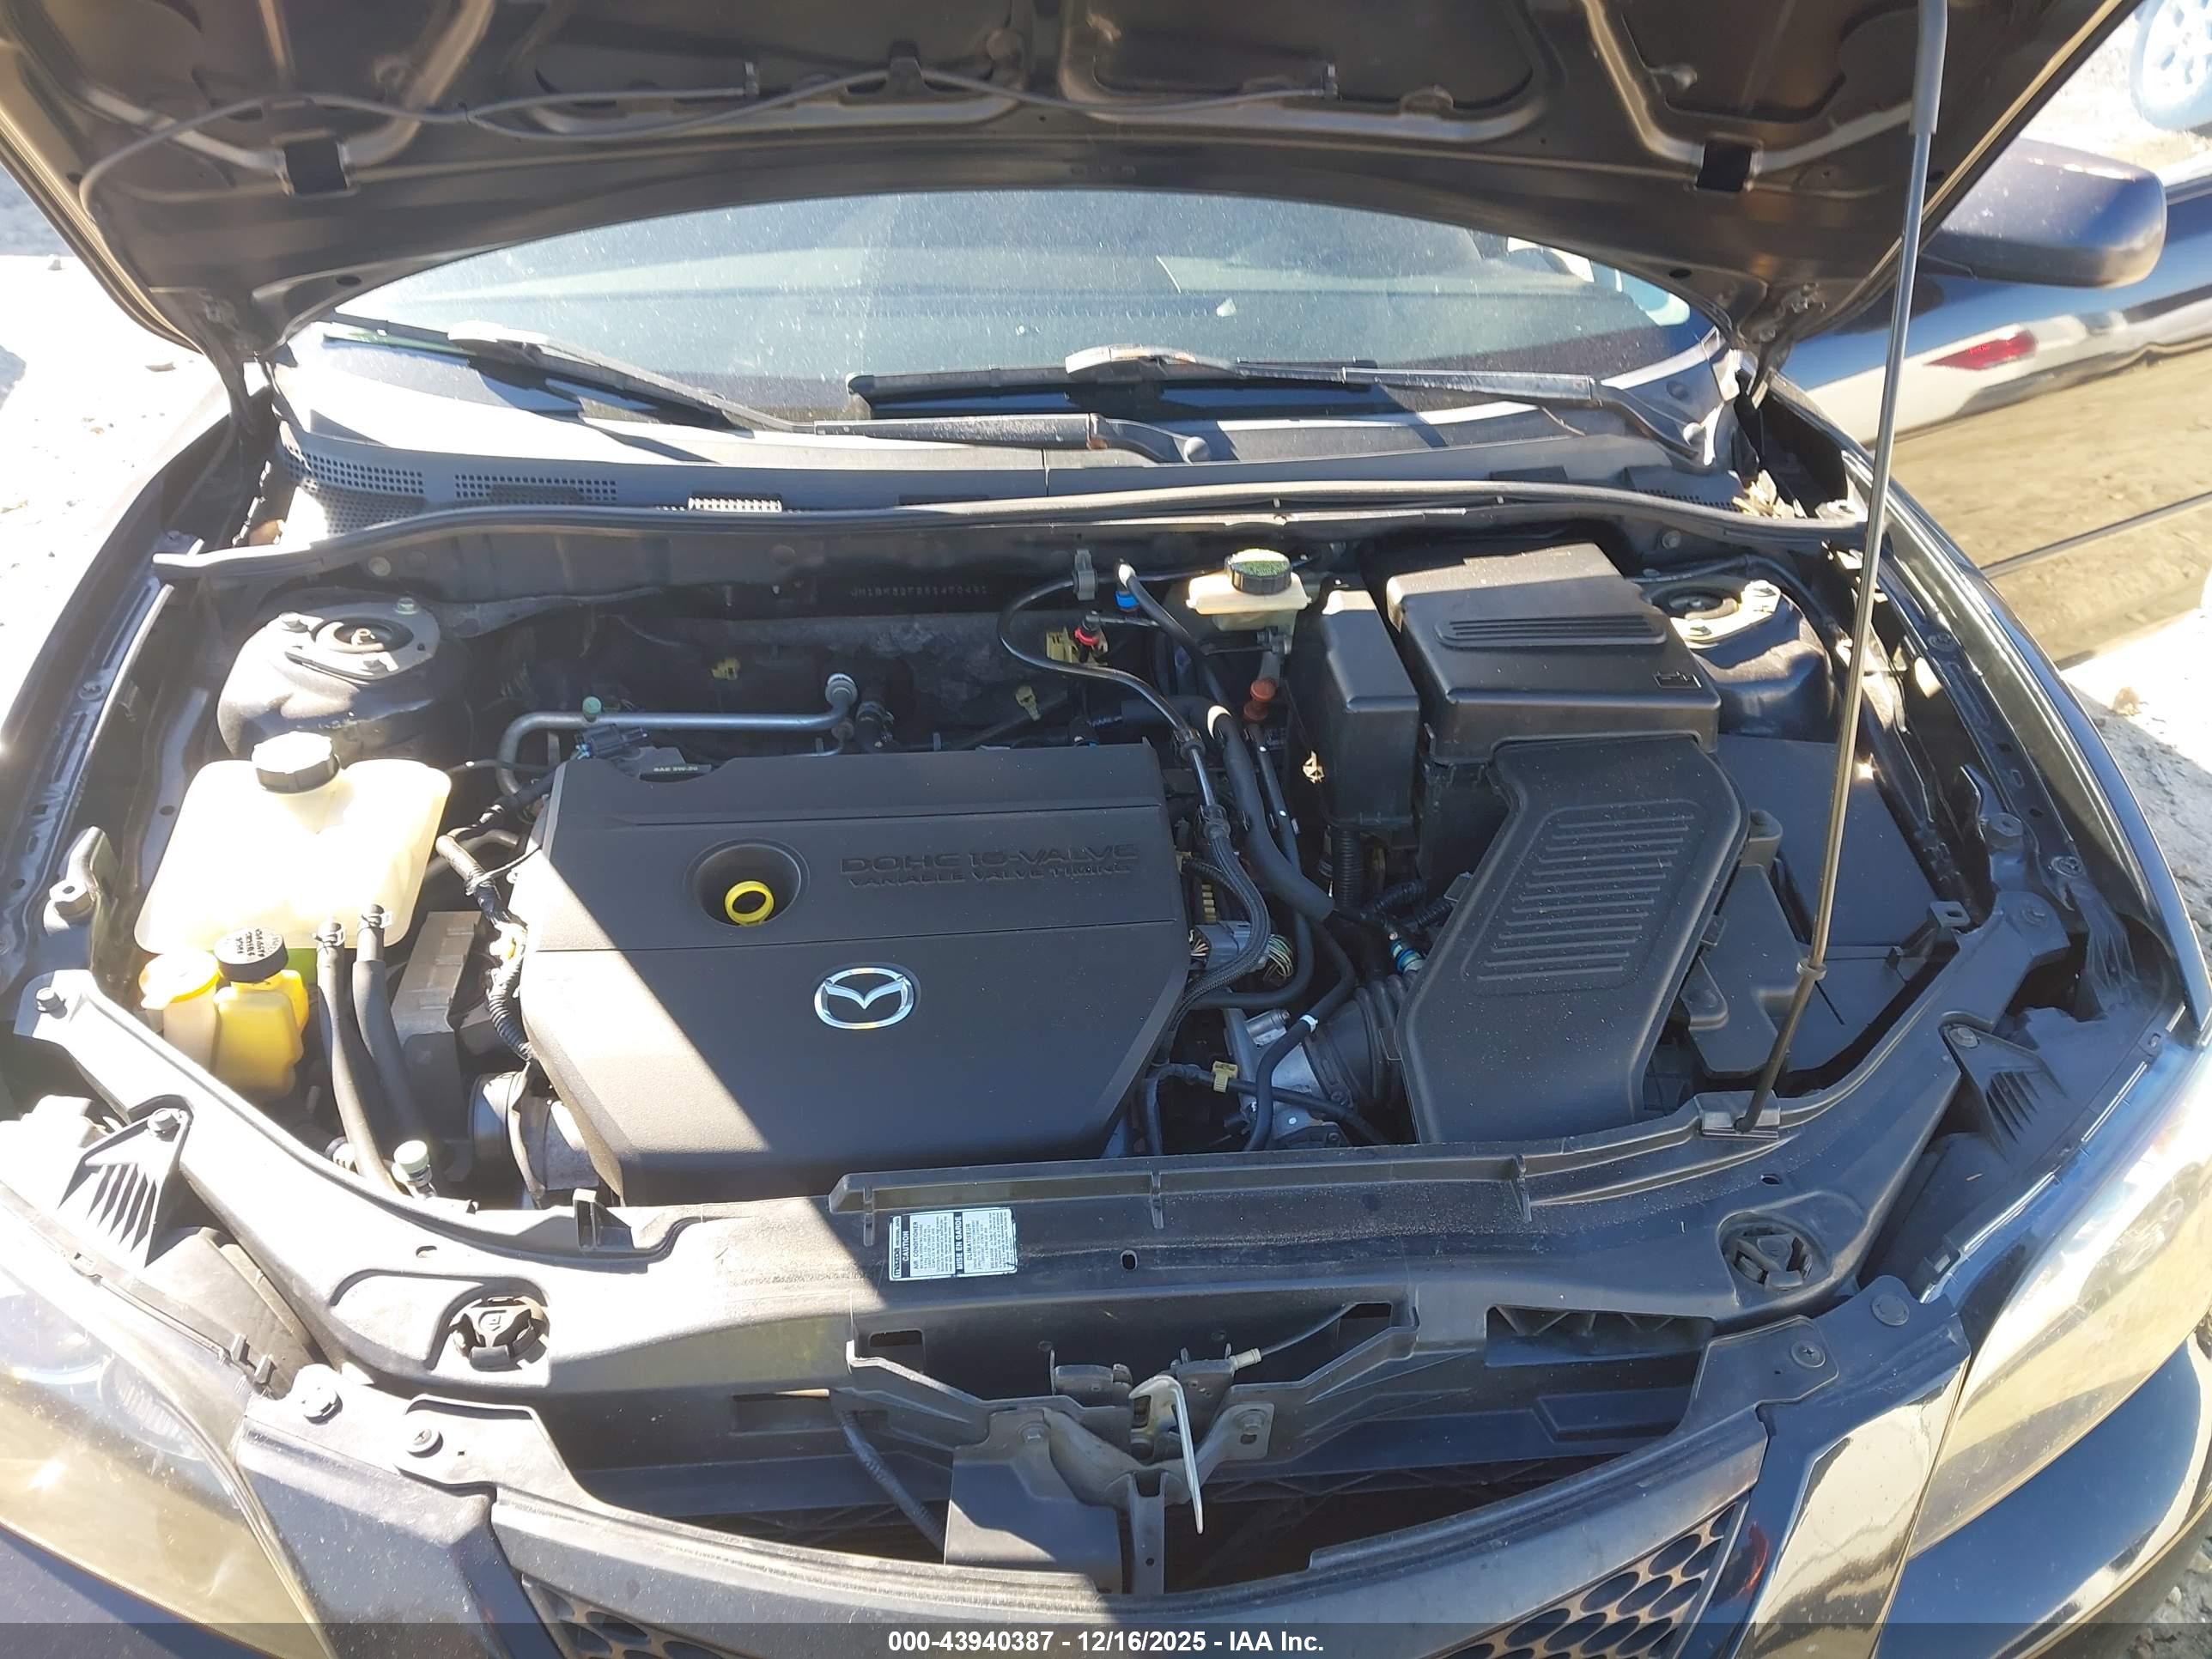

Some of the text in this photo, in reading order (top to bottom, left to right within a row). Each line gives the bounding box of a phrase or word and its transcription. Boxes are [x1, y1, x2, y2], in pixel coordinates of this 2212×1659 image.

[840, 843, 1139, 874] DOHC 16-VALVE
[972, 867, 1045, 882] VALVE
[956, 1242, 962, 1250] EN
